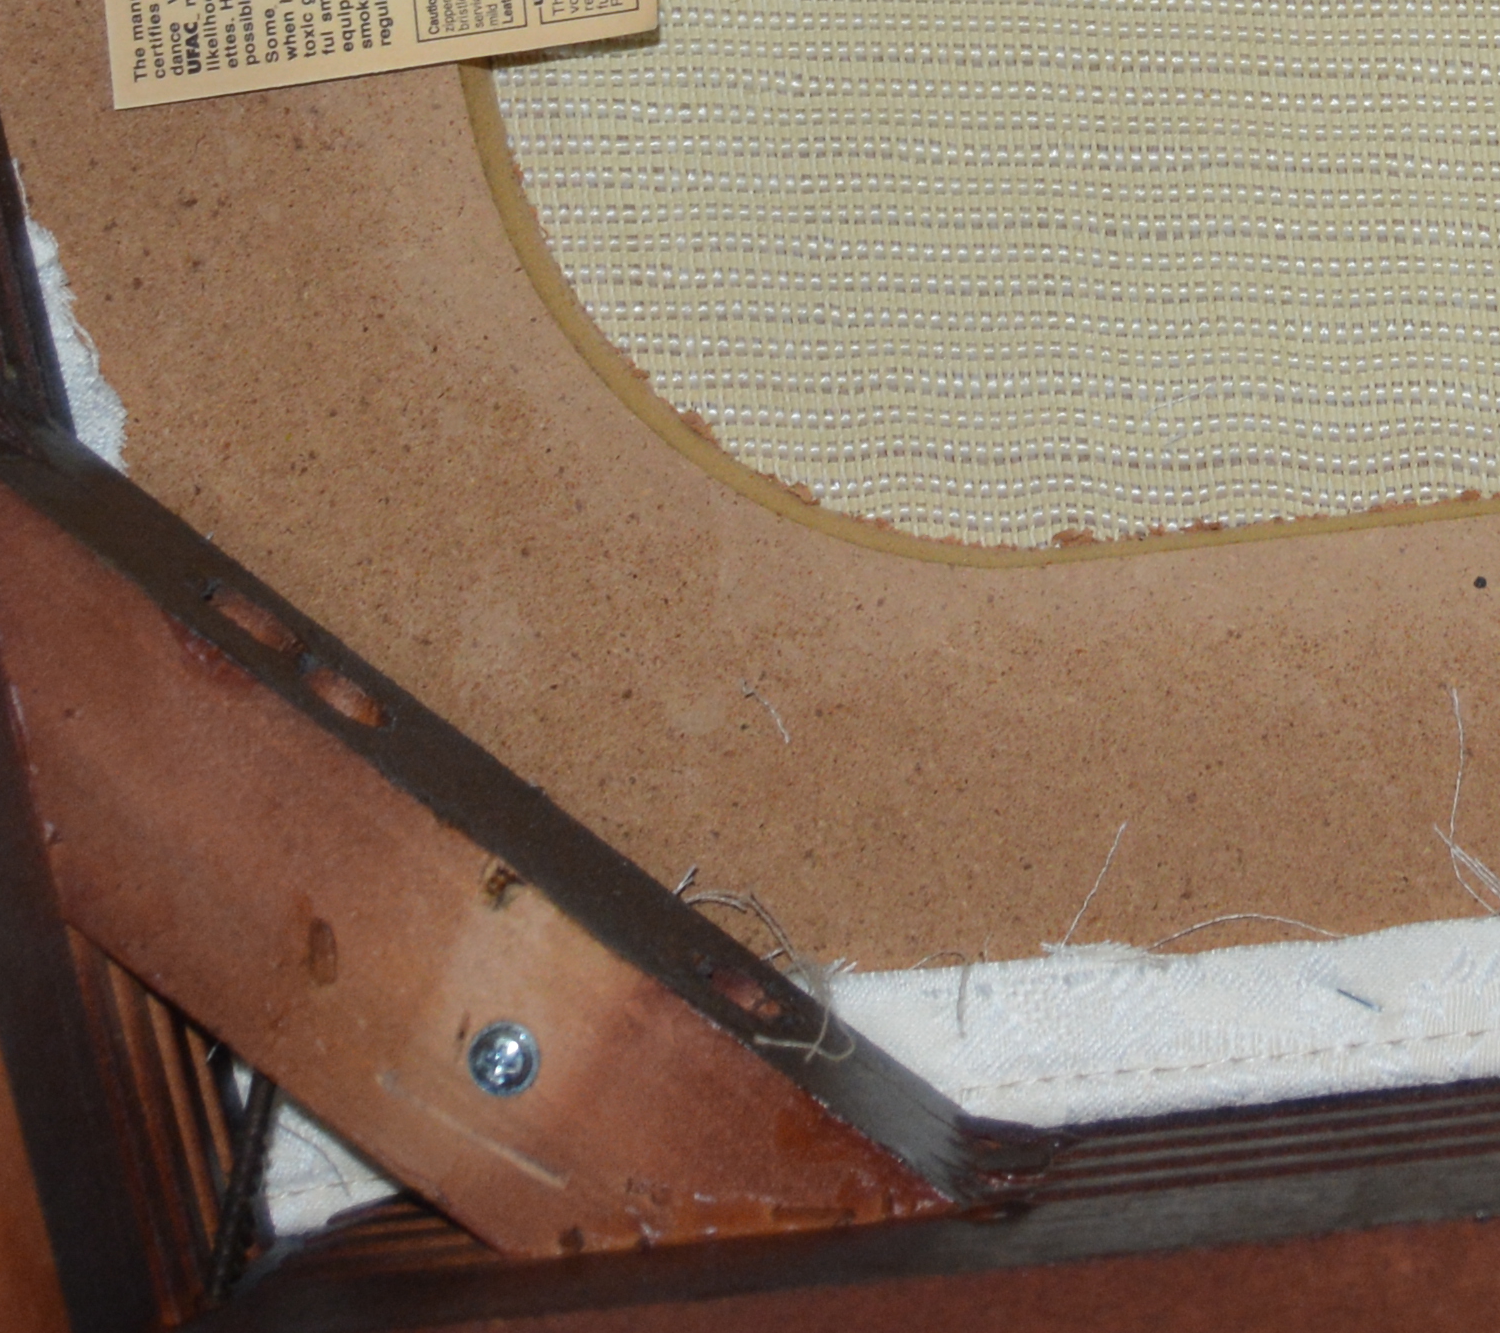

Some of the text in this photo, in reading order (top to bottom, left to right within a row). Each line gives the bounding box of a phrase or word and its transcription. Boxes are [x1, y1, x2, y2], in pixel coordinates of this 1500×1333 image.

[132, 46, 148, 83] The
[146, 1, 166, 79] certifies
[168, 21, 185, 77] dance
